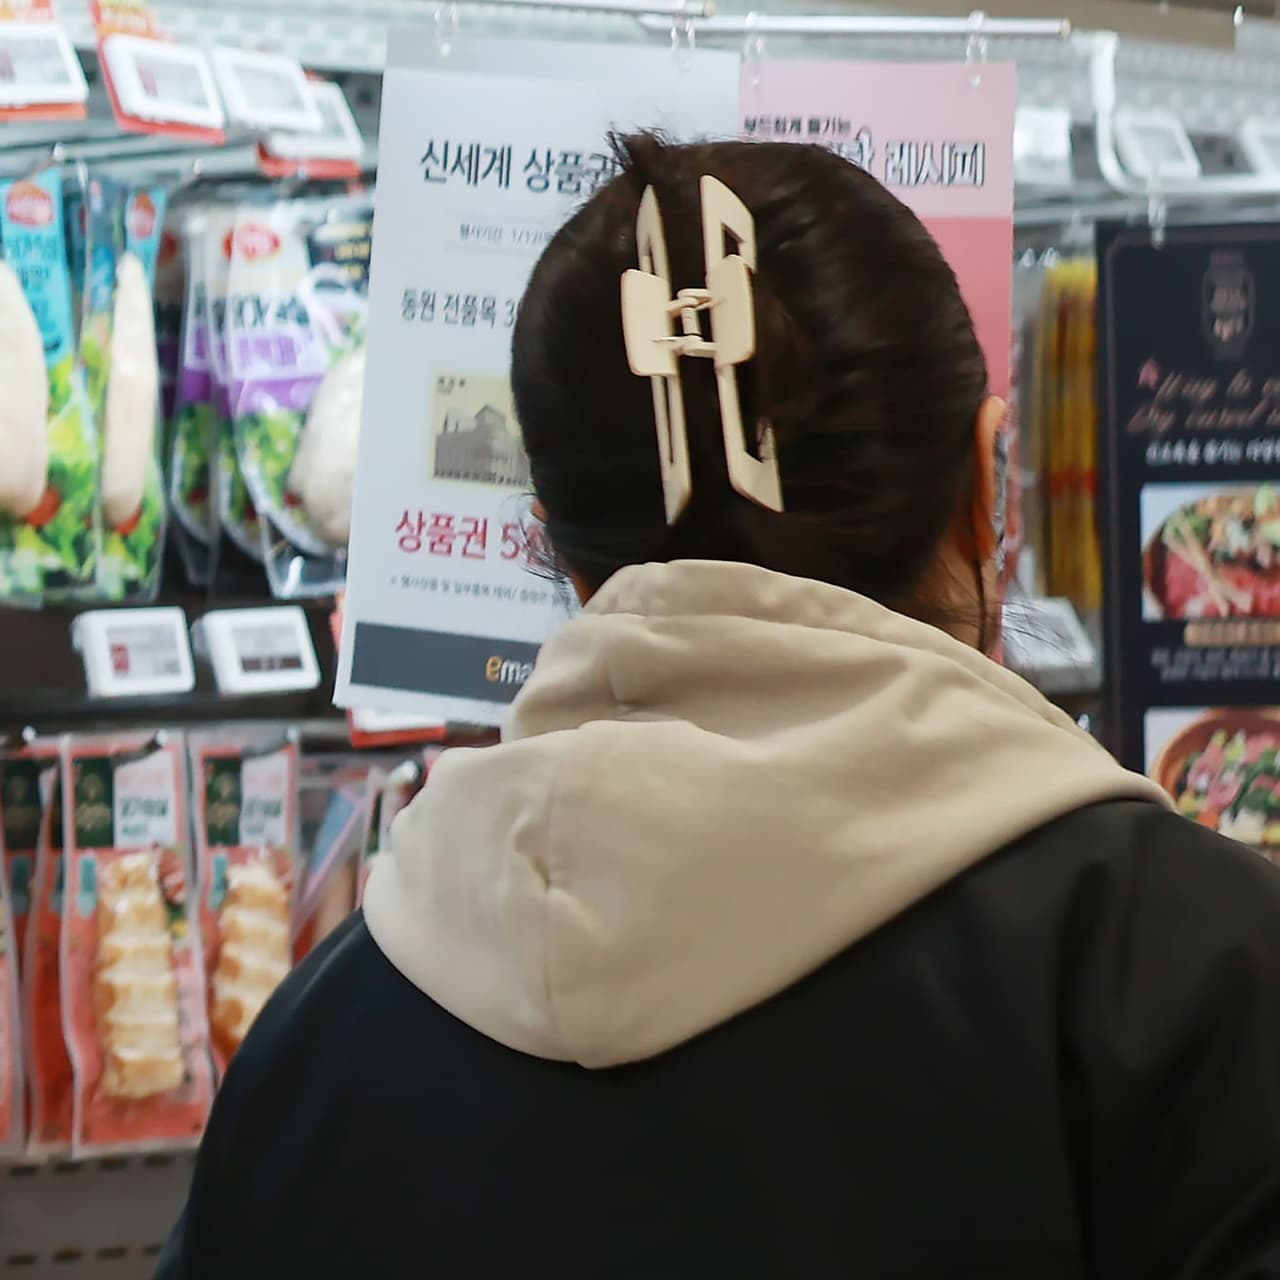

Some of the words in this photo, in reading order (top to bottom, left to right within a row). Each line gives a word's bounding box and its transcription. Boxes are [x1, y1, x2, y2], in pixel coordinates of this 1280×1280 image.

[420, 139, 513, 190] 신세계
[402, 288, 436, 323] 동원
[395, 509, 488, 560] 상품권
[485, 655, 536, 684] ema
